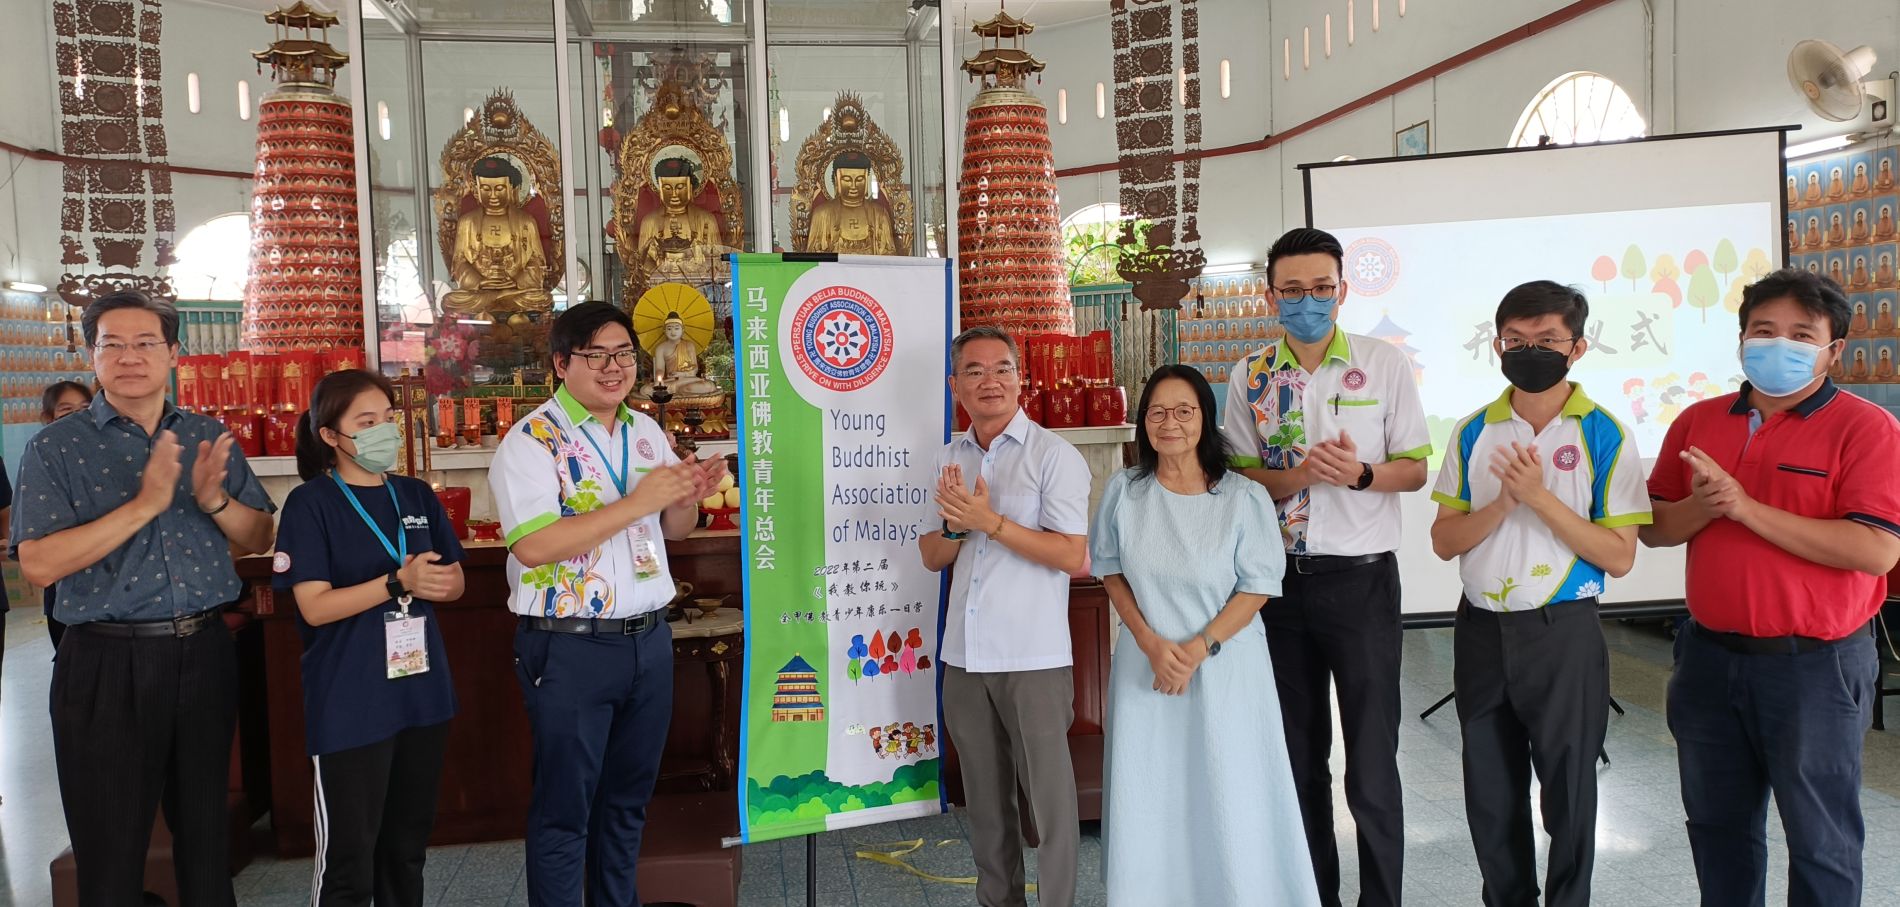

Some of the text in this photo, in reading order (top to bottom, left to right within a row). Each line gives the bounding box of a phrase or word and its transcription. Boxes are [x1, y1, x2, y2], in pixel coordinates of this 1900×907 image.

[793, 287, 892, 352] PERSATUAN BELIA BUDDHIST MALAYSIA
[808, 304, 829, 328] BUDDHIST
[830, 300, 866, 316] ASSOCIATION
[805, 329, 813, 350] YOUNG
[869, 322, 879, 352] MALAYSIA
[796, 354, 888, 390] STRIVE ON WITH DILIGENCE
[746, 286, 776, 570] 马来西亚佛教青年总会
[830, 408, 886, 437] Young
[832, 445, 909, 468] Buddhist
[833, 519, 850, 543] of
[813, 558, 889, 576] 2022年第二届
[813, 581, 899, 599] 《我教你玩》
